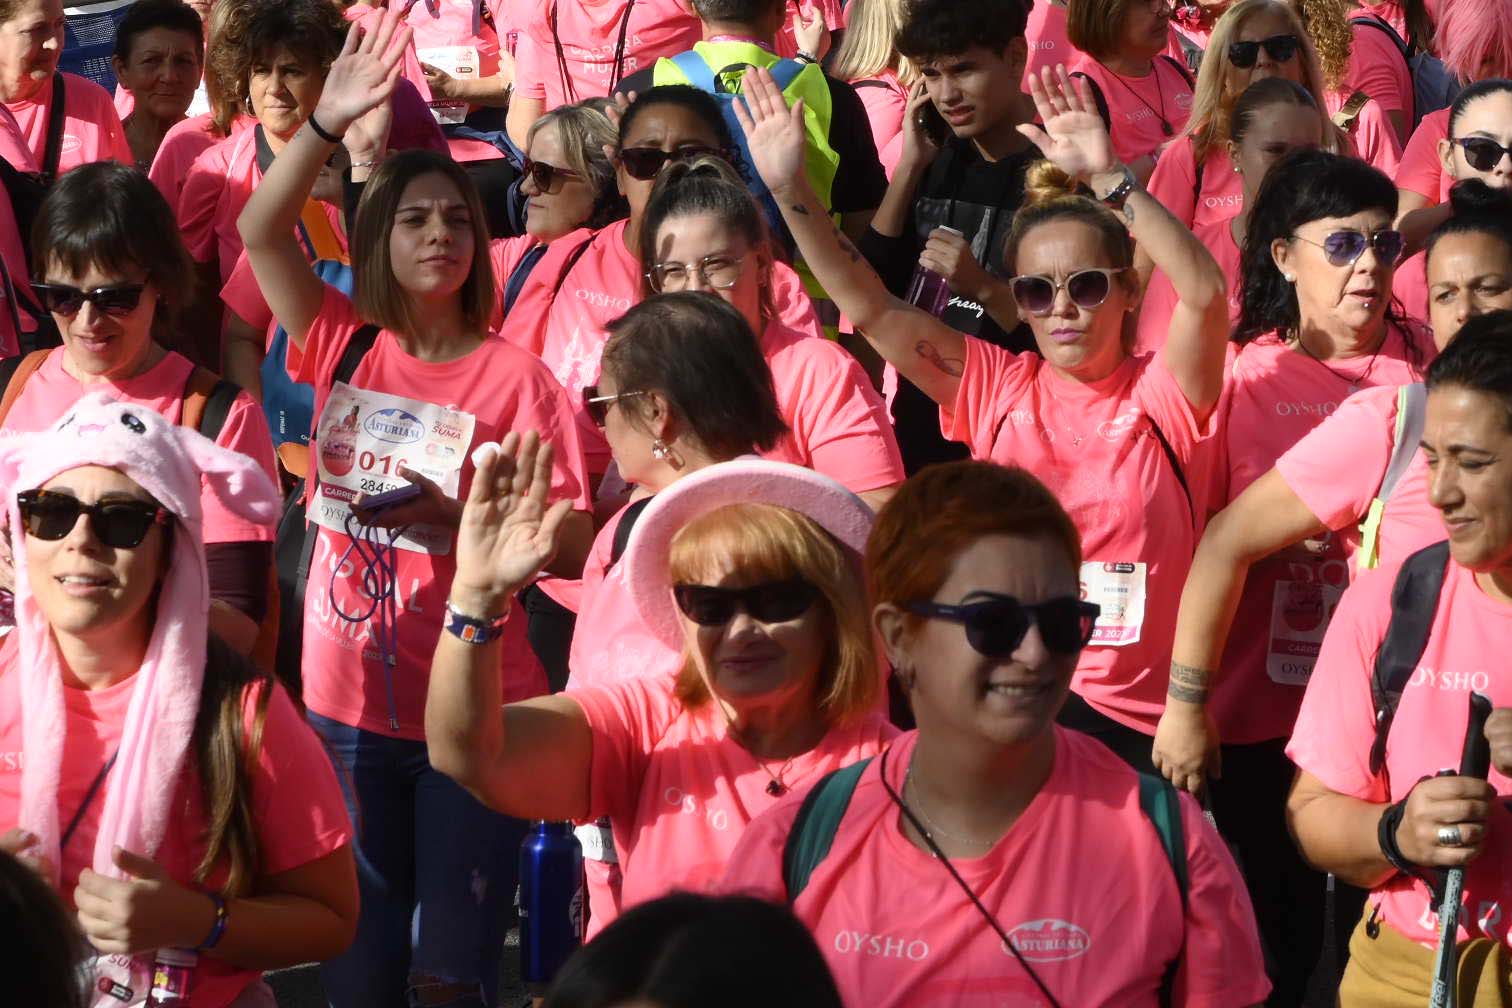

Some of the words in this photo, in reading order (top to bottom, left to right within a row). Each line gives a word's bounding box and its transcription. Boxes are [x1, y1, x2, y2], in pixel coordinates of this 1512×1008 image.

[1205, 193, 1244, 209] OYSH
[575, 289, 630, 311] OYSHO
[1409, 669, 1489, 692] OYSHO
[834, 929, 930, 962] OYSHO
